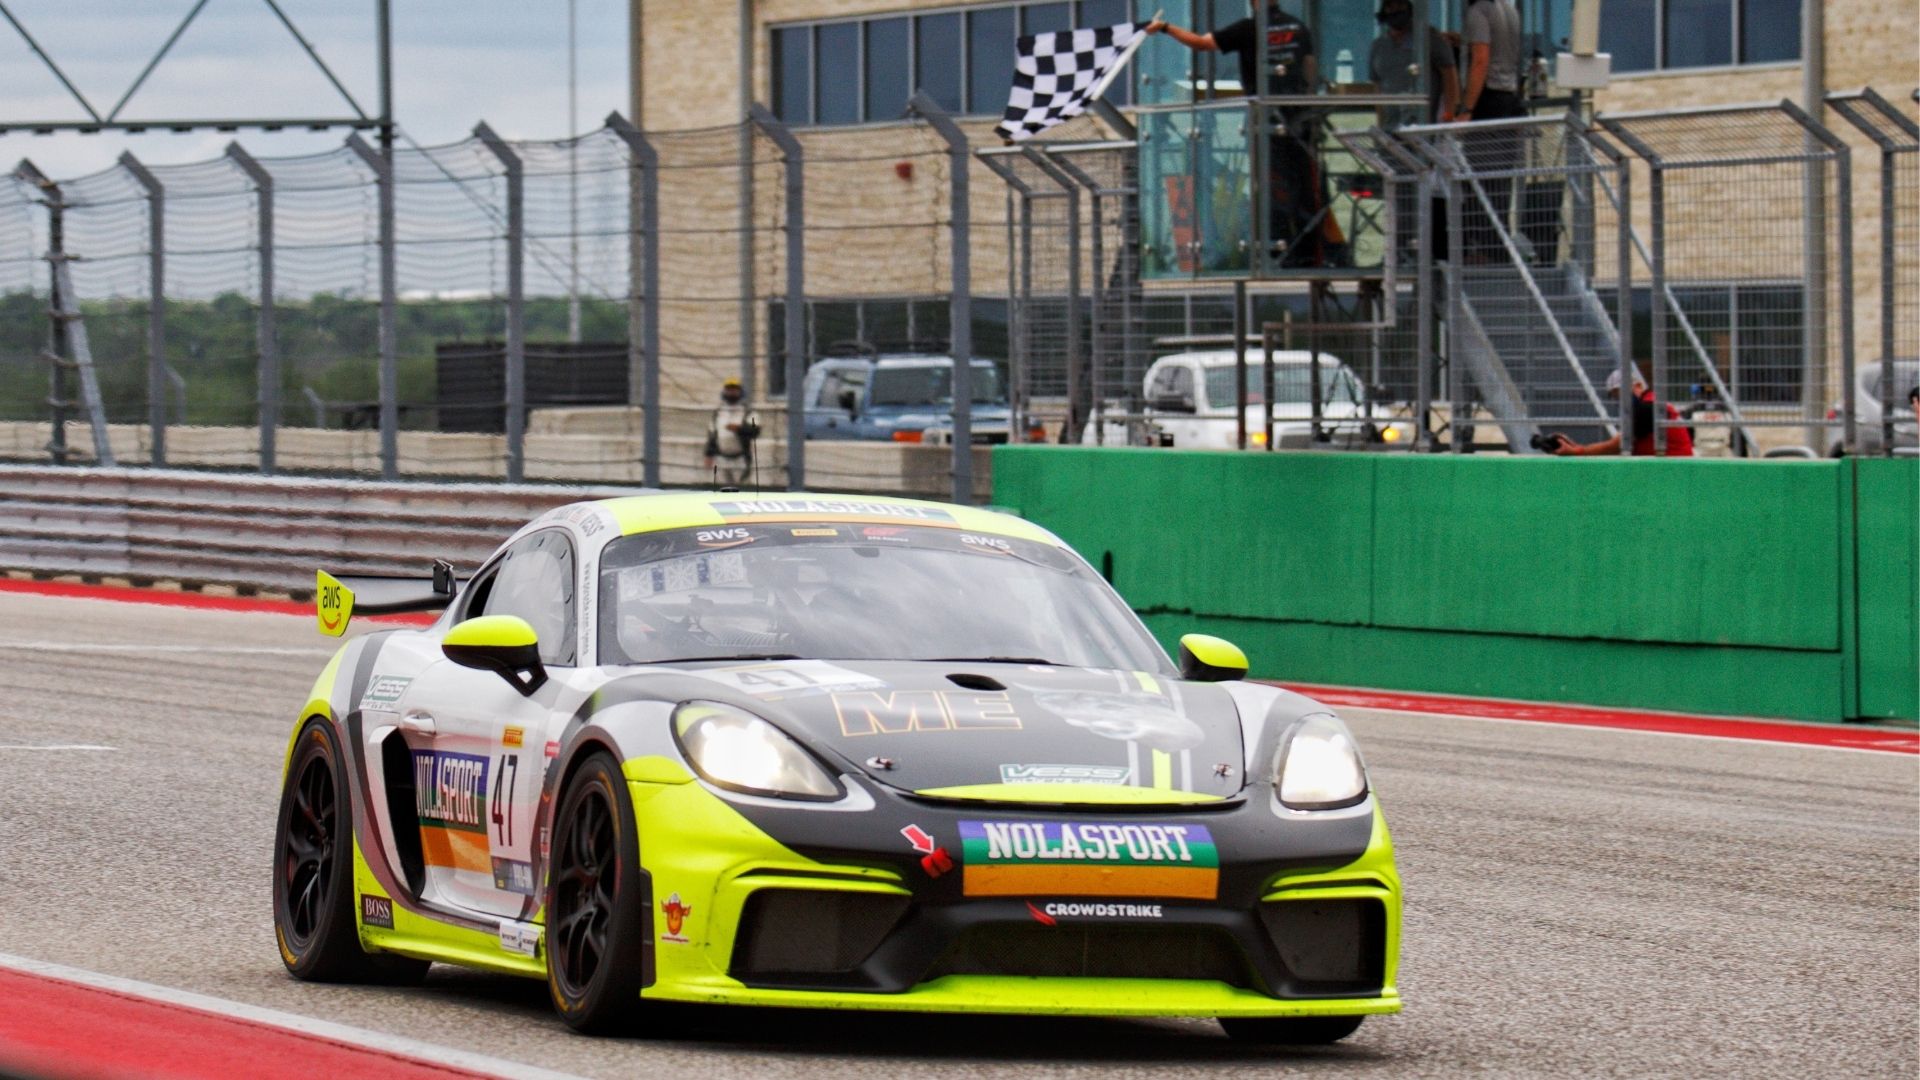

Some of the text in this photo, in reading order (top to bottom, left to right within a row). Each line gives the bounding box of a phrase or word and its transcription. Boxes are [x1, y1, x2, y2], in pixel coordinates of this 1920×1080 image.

[735, 500, 928, 518] NOLASPORT
[696, 527, 750, 541] aws
[960, 534, 1010, 549] aws
[322, 586, 341, 609] aws
[735, 669, 819, 686] 47
[830, 689, 1023, 737] ME
[416, 755, 483, 825] NOLASPORT
[491, 754, 518, 847] 47
[982, 822, 1193, 862] NOLASPORT
[365, 897, 390, 919] BOSS
[1045, 903, 1162, 918] CROWDSTRIKE
